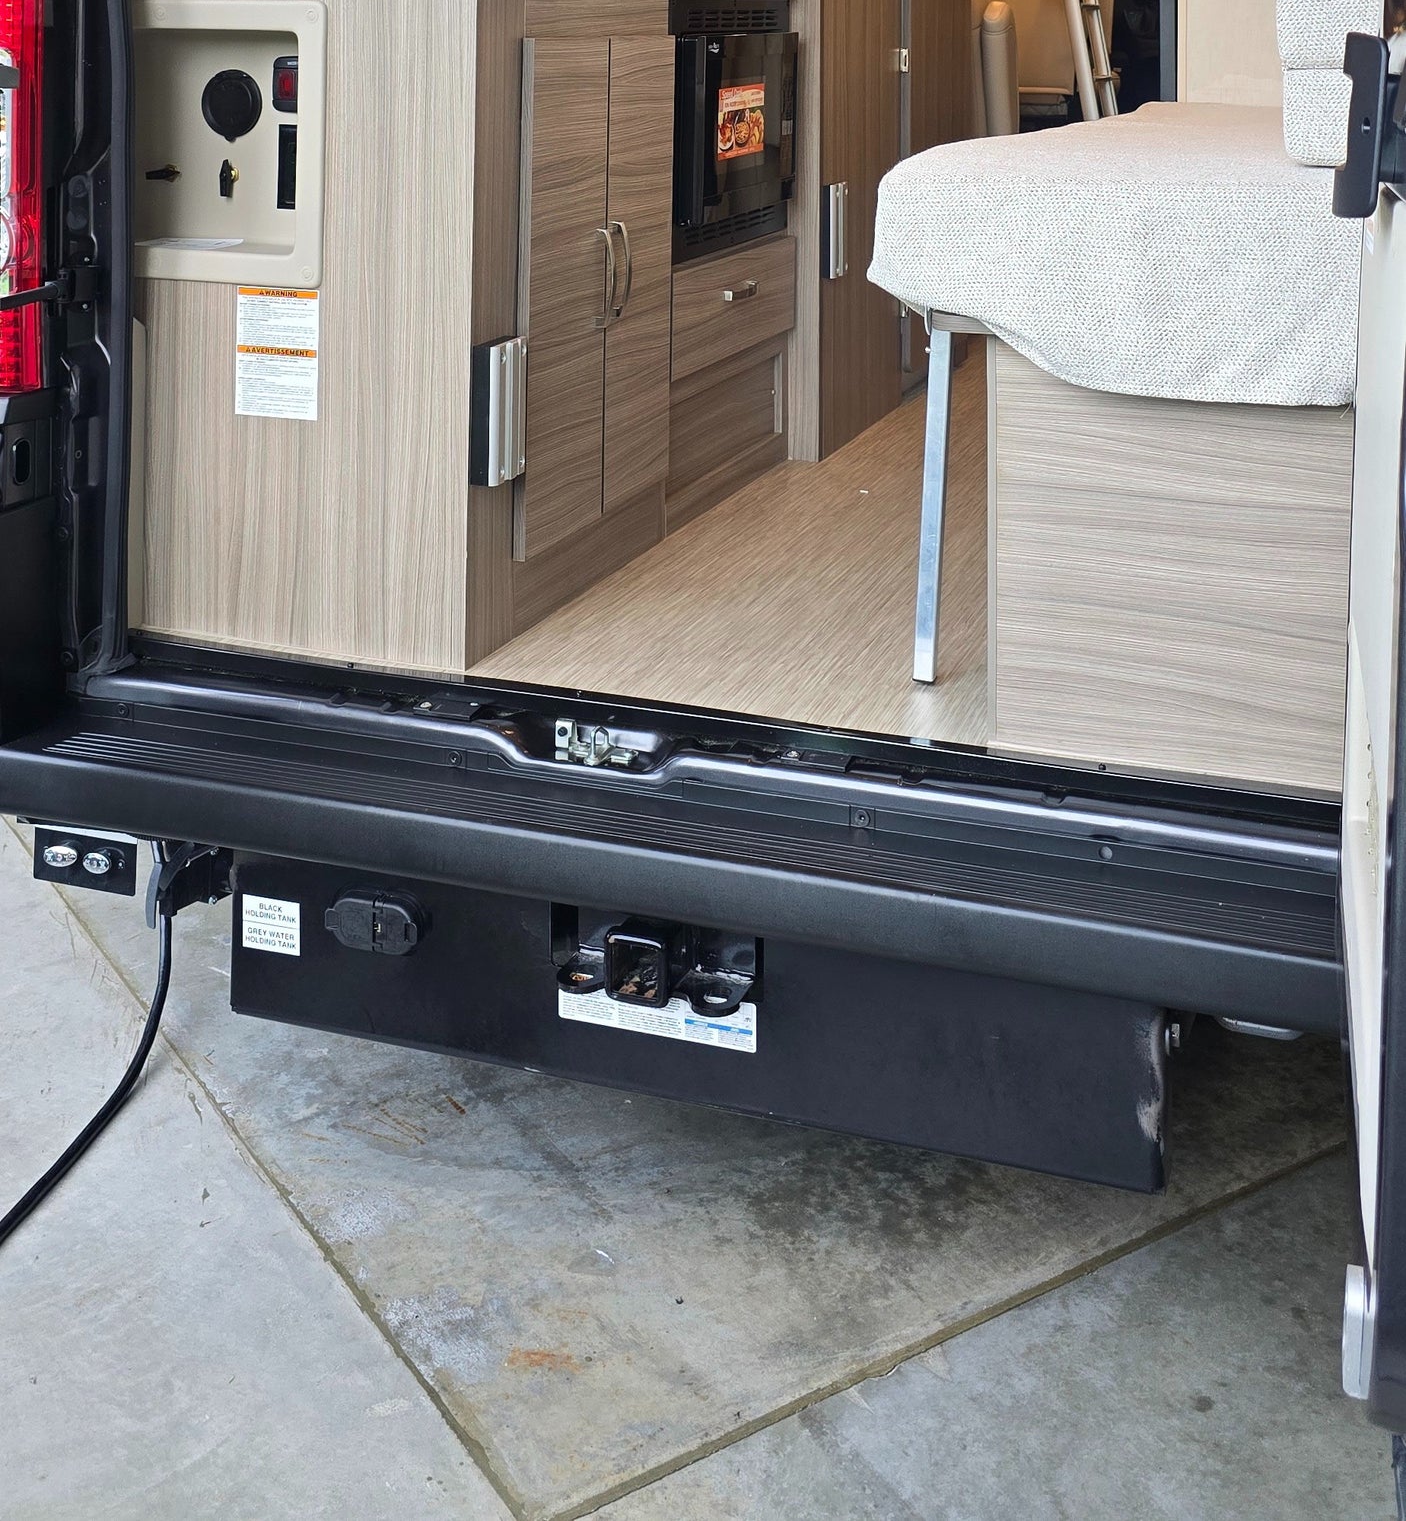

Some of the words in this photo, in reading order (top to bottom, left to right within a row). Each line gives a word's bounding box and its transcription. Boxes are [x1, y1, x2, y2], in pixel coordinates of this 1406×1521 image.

[265, 290, 298, 298] WARNING
[252, 346, 309, 357] AVERTISSEMENT
[259, 903, 282, 913] BLACK
[245, 909, 276, 919] HOLDING
[278, 914, 296, 924] TANK
[247, 927, 267, 936] GREY
[269, 932, 295, 941] WATER
[245, 936, 276, 946] HOLDING
[278, 941, 297, 950] TANK
